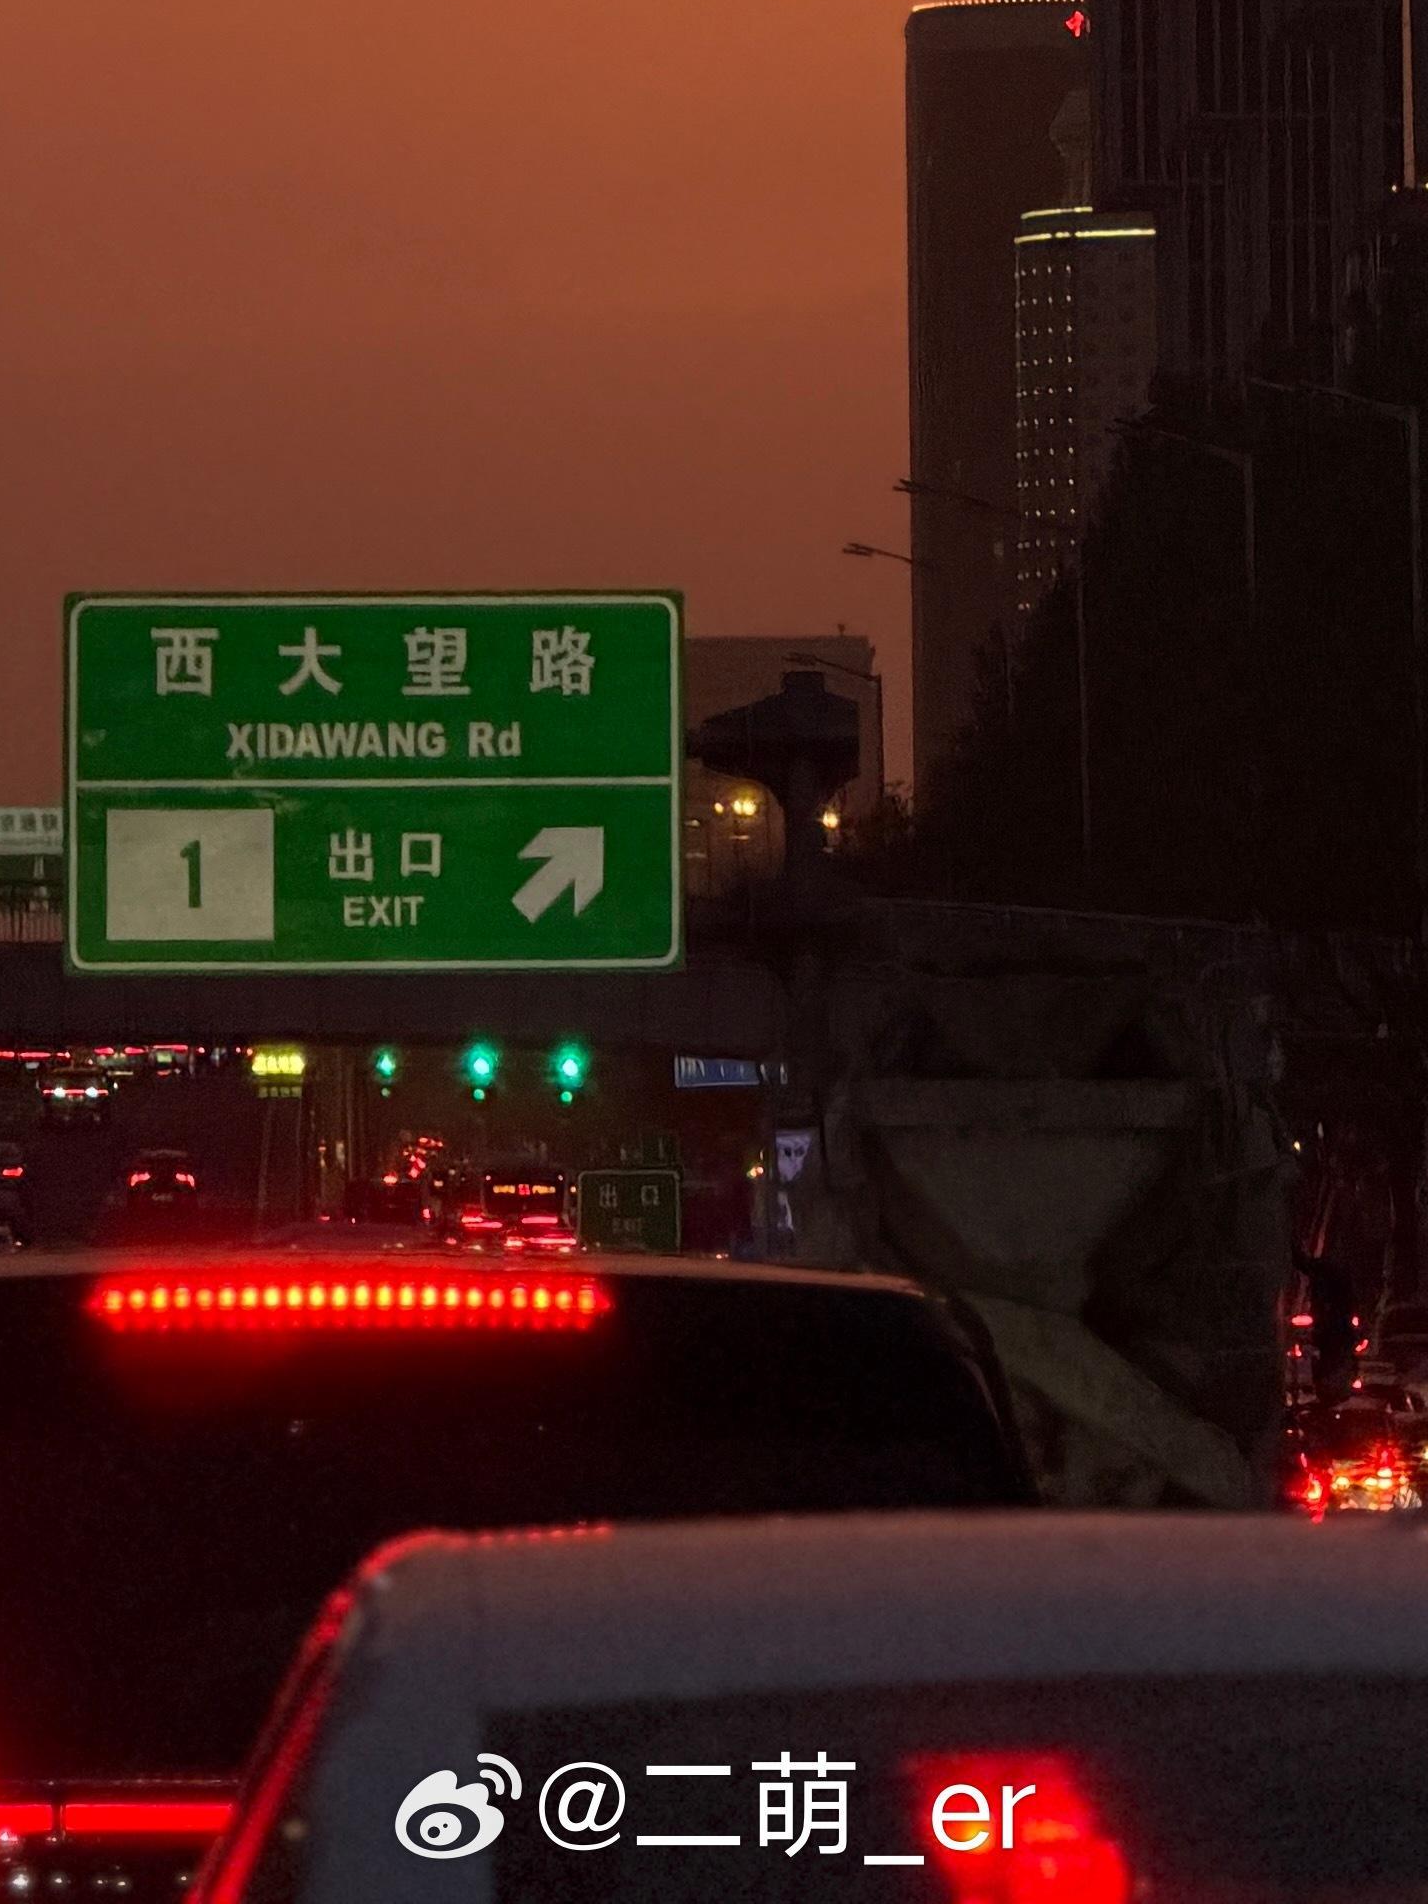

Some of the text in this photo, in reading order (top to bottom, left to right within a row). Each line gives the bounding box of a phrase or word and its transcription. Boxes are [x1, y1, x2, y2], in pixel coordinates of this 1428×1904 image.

[150, 626, 595, 697] 西大望路
[226, 722, 521, 759] XIDAWANG Rd
[180, 840, 202, 909] 1
[327, 828, 442, 882] 出口
[344, 896, 424, 927] EXIT
